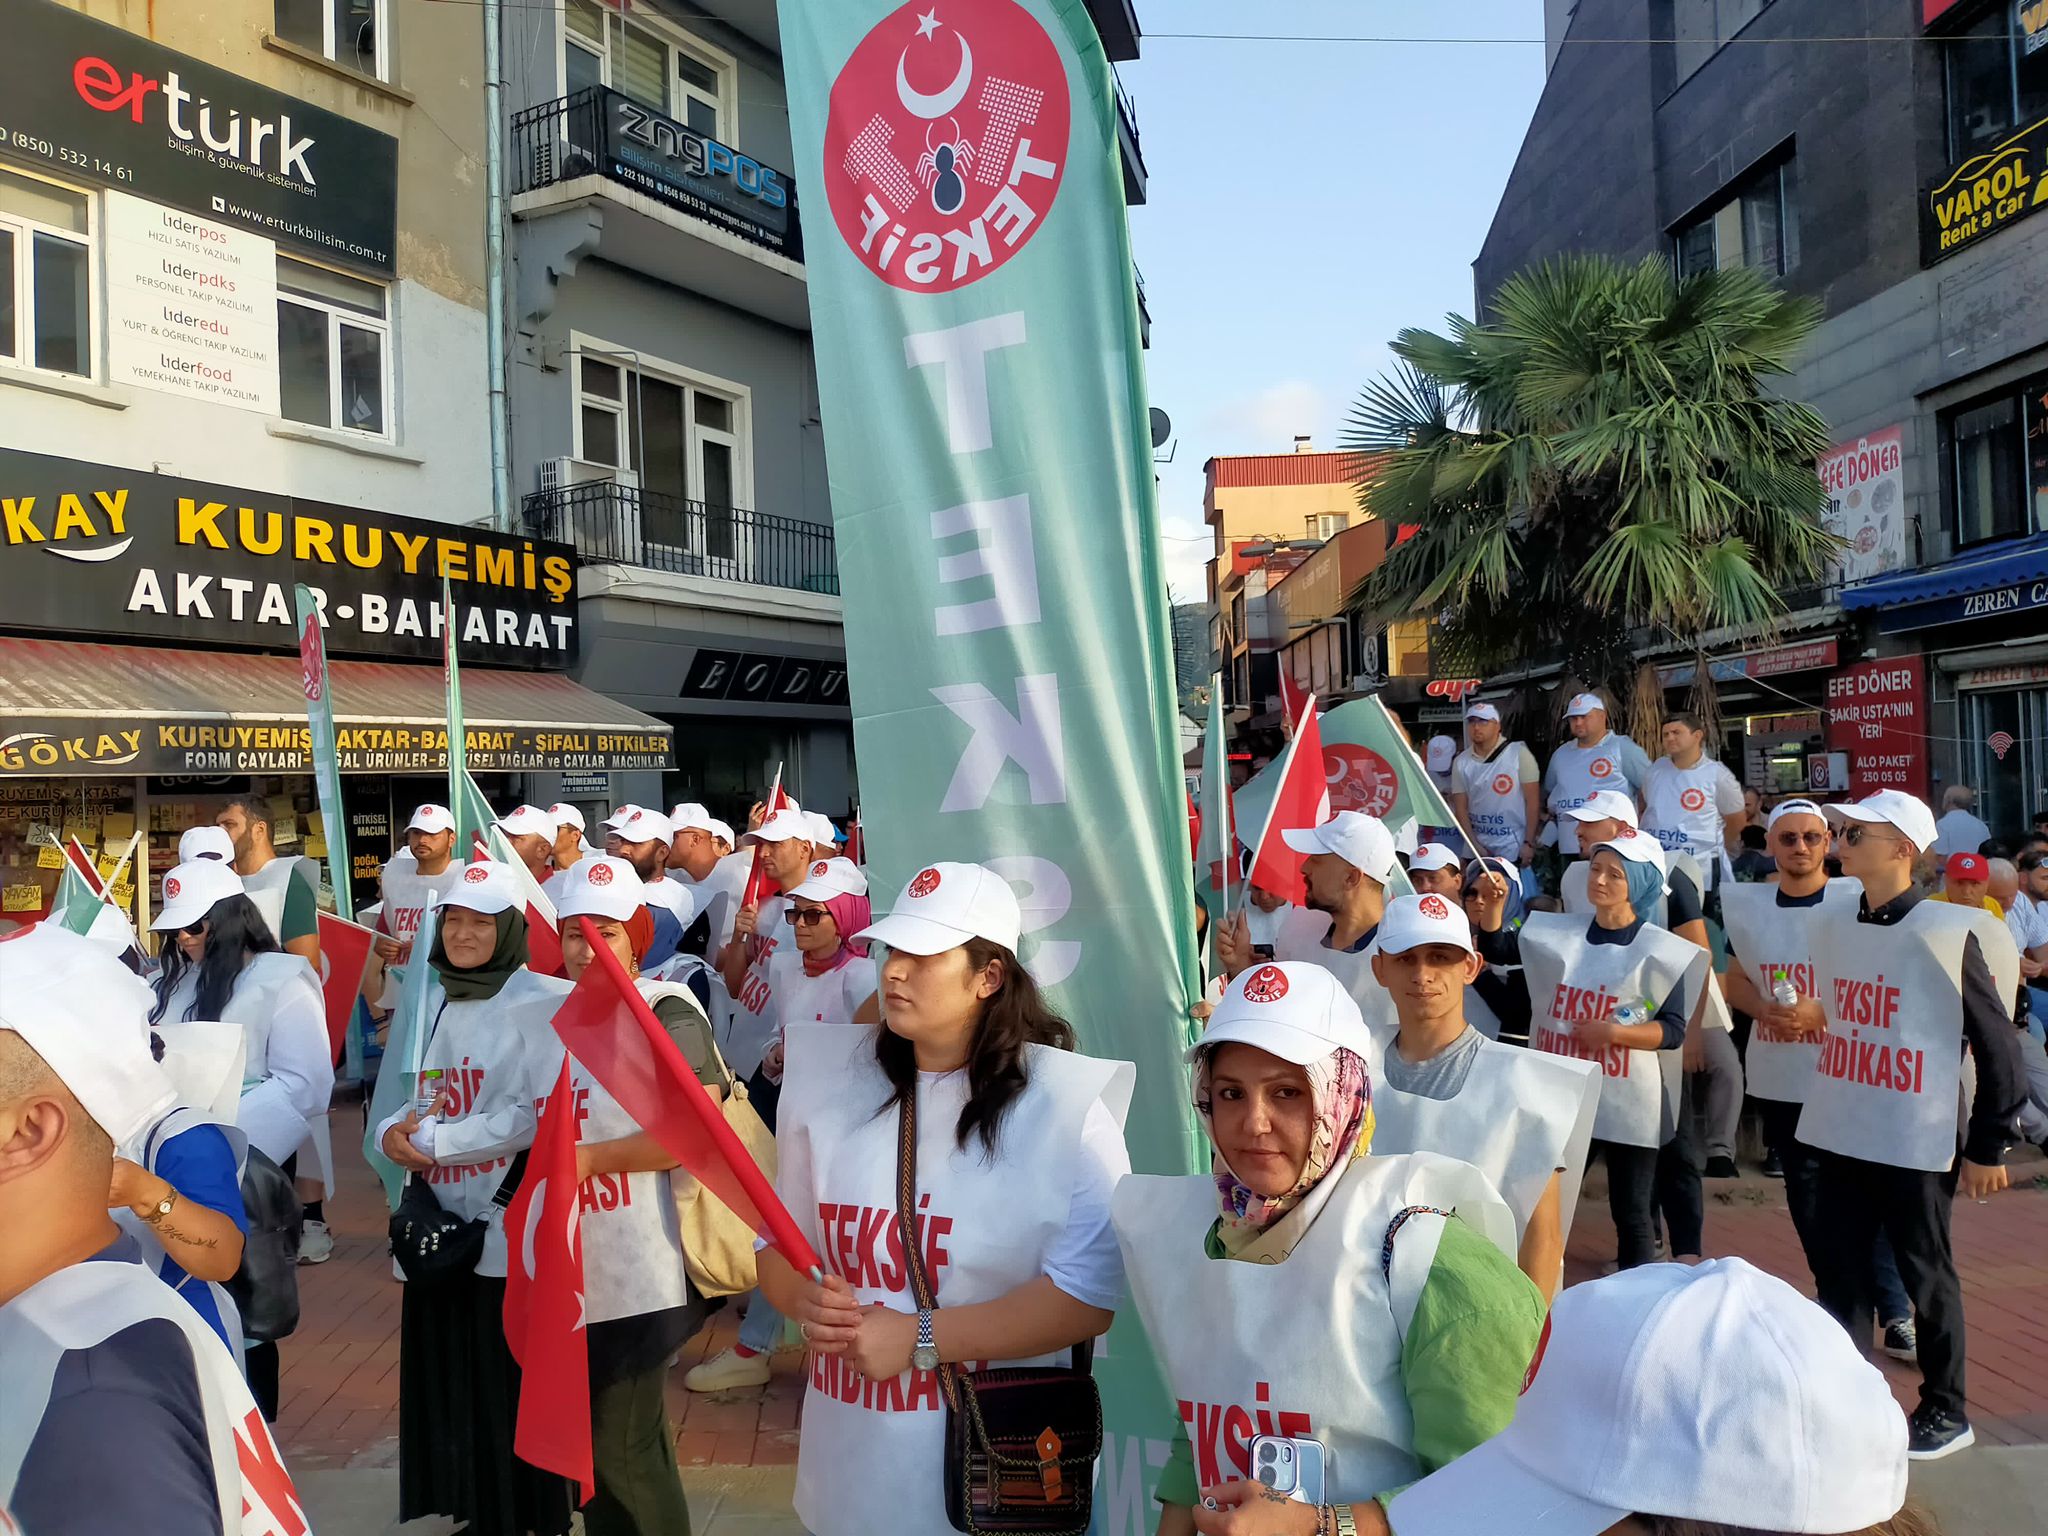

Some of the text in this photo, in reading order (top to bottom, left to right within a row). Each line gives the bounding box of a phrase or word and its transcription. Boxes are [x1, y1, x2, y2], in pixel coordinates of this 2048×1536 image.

[12, 130, 54, 158] (850)
[59, 147, 88, 168] 532
[94, 158, 112, 175] 14
[117, 166, 134, 182] 61
[168, 136, 317, 198] bilişim & güvenlik sistemleri
[1936, 158, 2031, 229] VAROL
[229, 202, 388, 263] www.erturkbilisim.com.tr
[1940, 191, 2026, 250] Rent a Car
[148, 230, 174, 248] HIZLI
[136, 274, 185, 296] PERSONEL
[122, 318, 147, 335] YURT
[151, 325, 159, 337] &
[132, 366, 191, 389] YEMEKHANE
[1848, 439, 1899, 489] DÖNER
[1, 489, 573, 604] KAY KURUYEMİŞ
[1964, 587, 2020, 617] ZEREN
[1829, 669, 1912, 698] EFE DÖNER
[1830, 702, 1860, 723] ŞAKİR
[1859, 718, 1882, 739] YERİ
[0, 729, 141, 771] GÖKAY
[185, 752, 231, 769] FORM
[500, 751, 543, 769] YAĞLAR
[547, 757, 560, 769] ve
[1857, 754, 1911, 768] ALO PAKET
[1863, 770, 1907, 783] 250 05 05
[74, 787, 120, 799] AKTAR
[21, 807, 61, 819] KURU
[66, 804, 114, 817] KAHVE
[353, 813, 387, 825] BİTKİSEL
[354, 853, 381, 867] DOĞAL
[1833, 974, 1900, 1029] TEKSİF
[1816, 1029, 1924, 1094] ENDİKASI
[819, 1193, 953, 1297] TEKSİF
